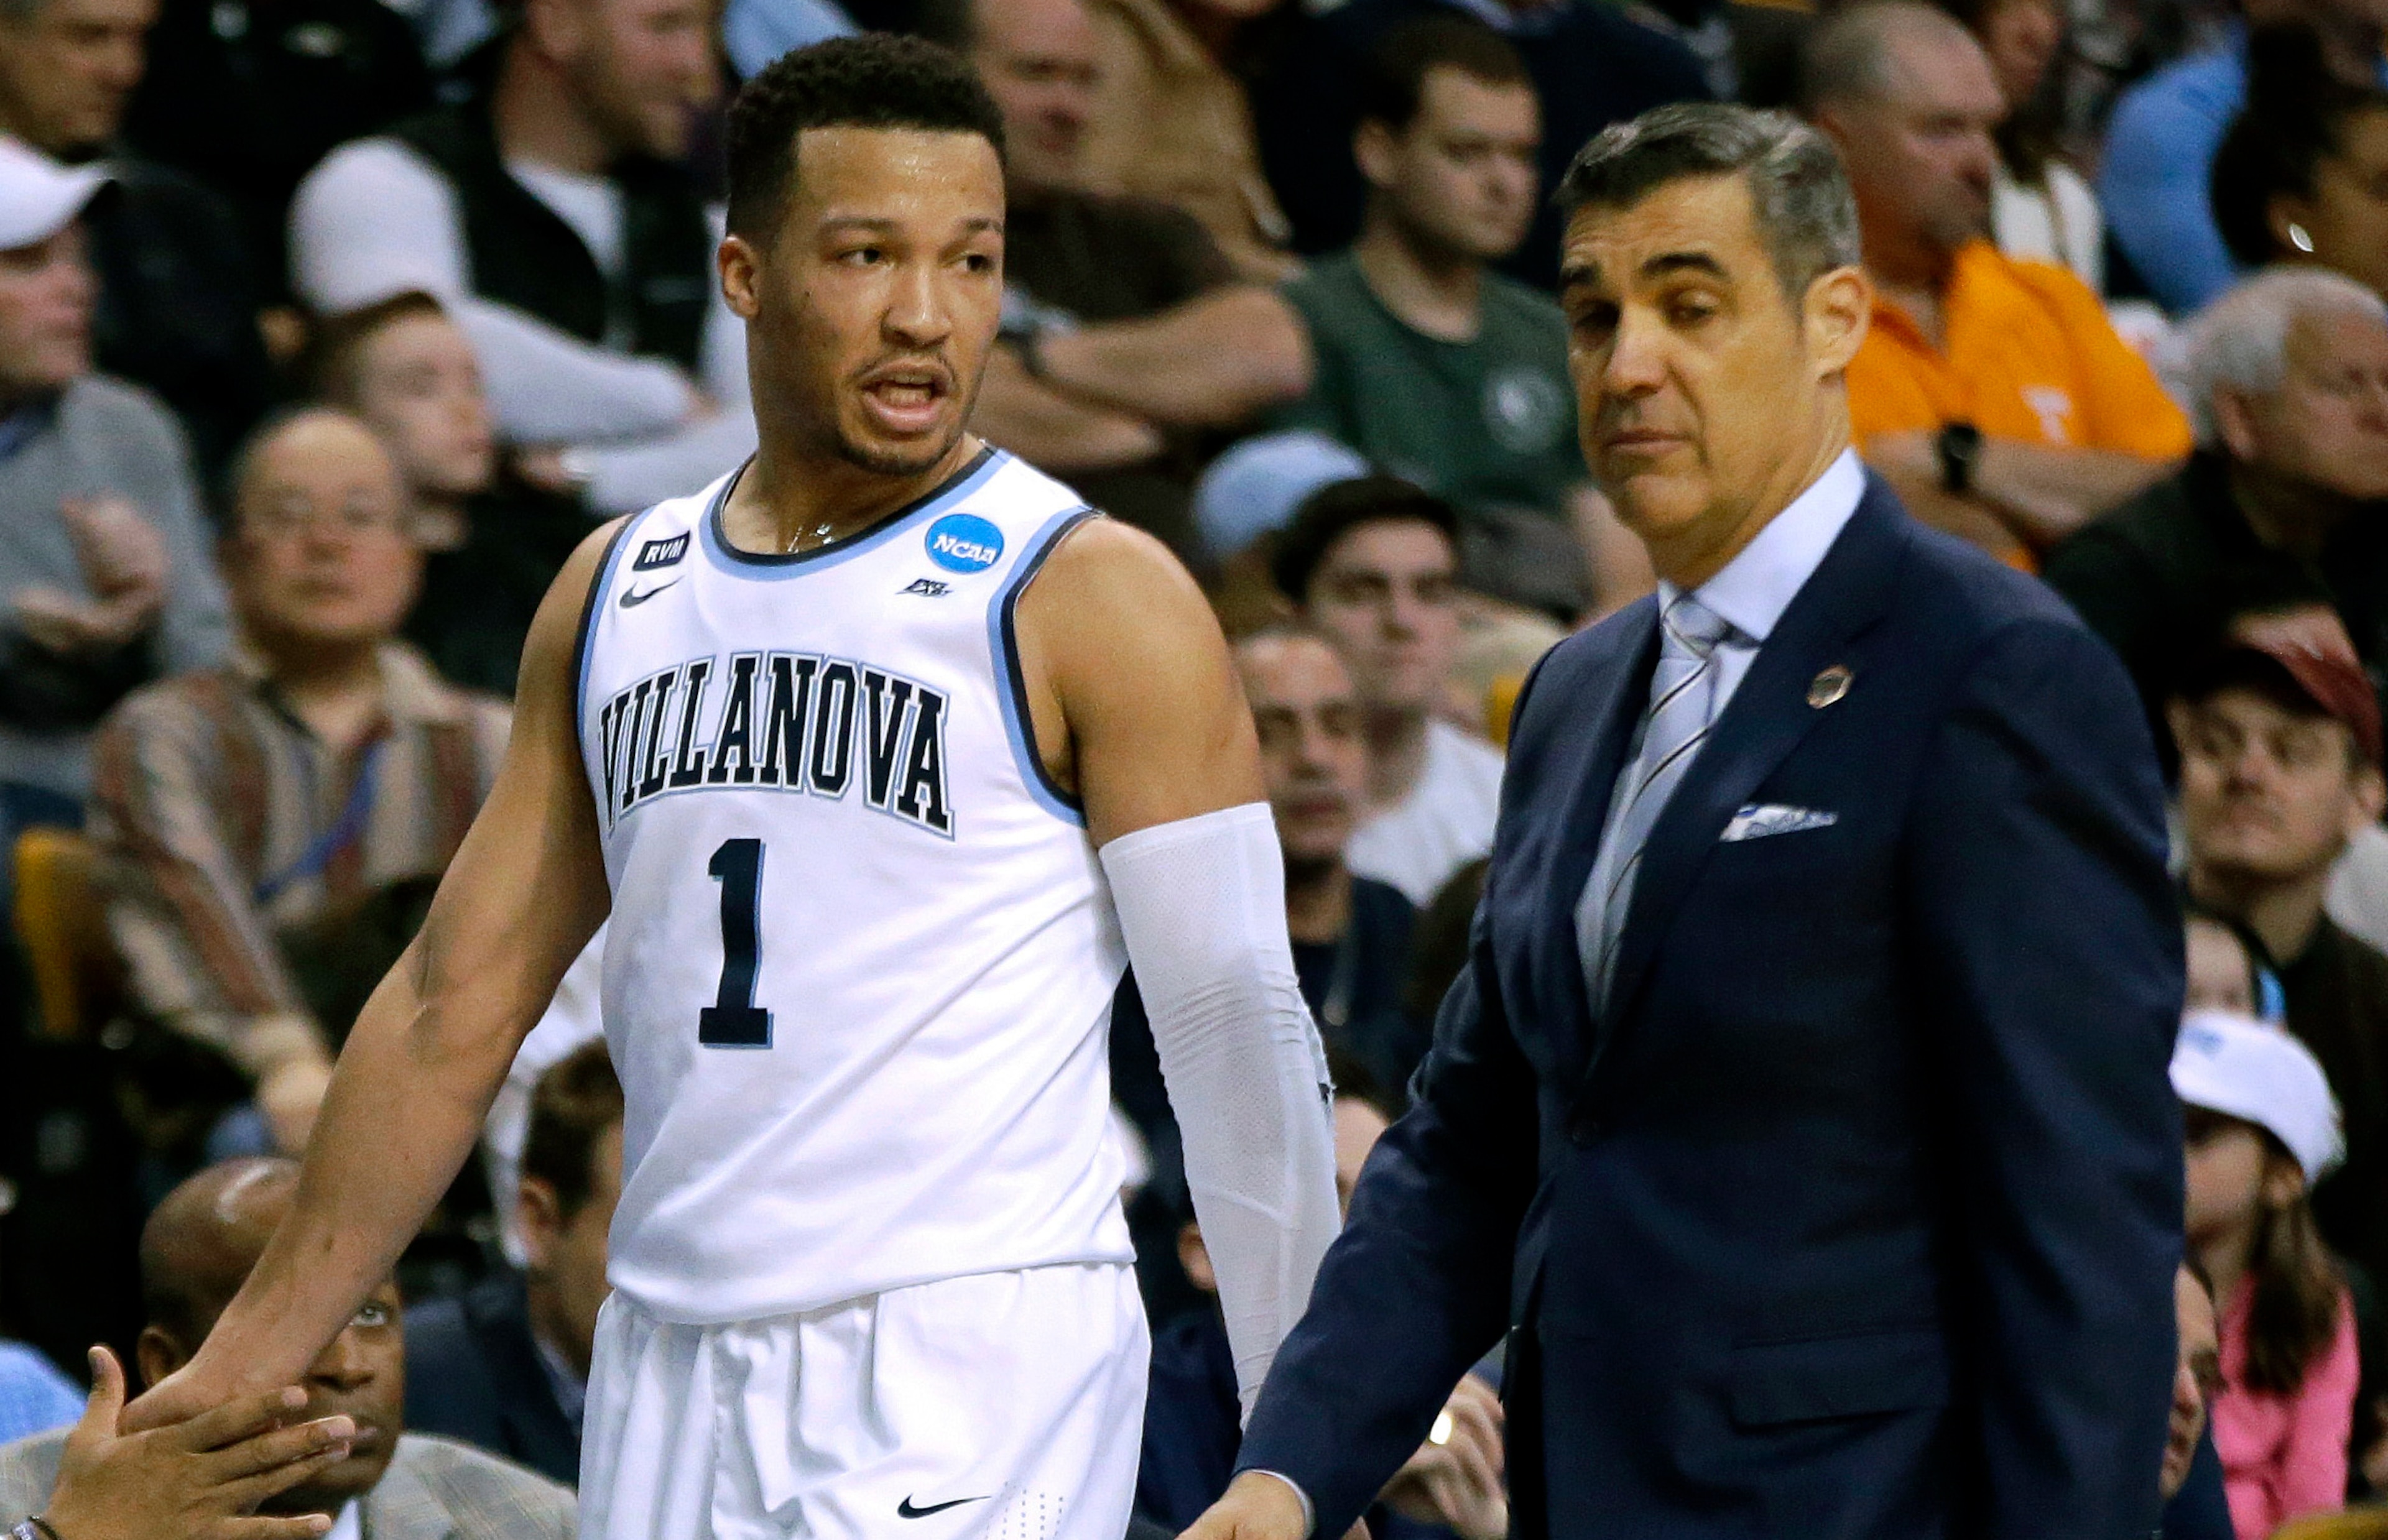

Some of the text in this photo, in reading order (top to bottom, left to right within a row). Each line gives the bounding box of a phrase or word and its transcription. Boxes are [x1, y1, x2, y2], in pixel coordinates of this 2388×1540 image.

[2019, 384, 2073, 444] T
[644, 538, 685, 563] RVM
[933, 533, 997, 565] NCAA
[599, 650, 954, 841] VILLANOVA
[699, 838, 774, 1049] 1
